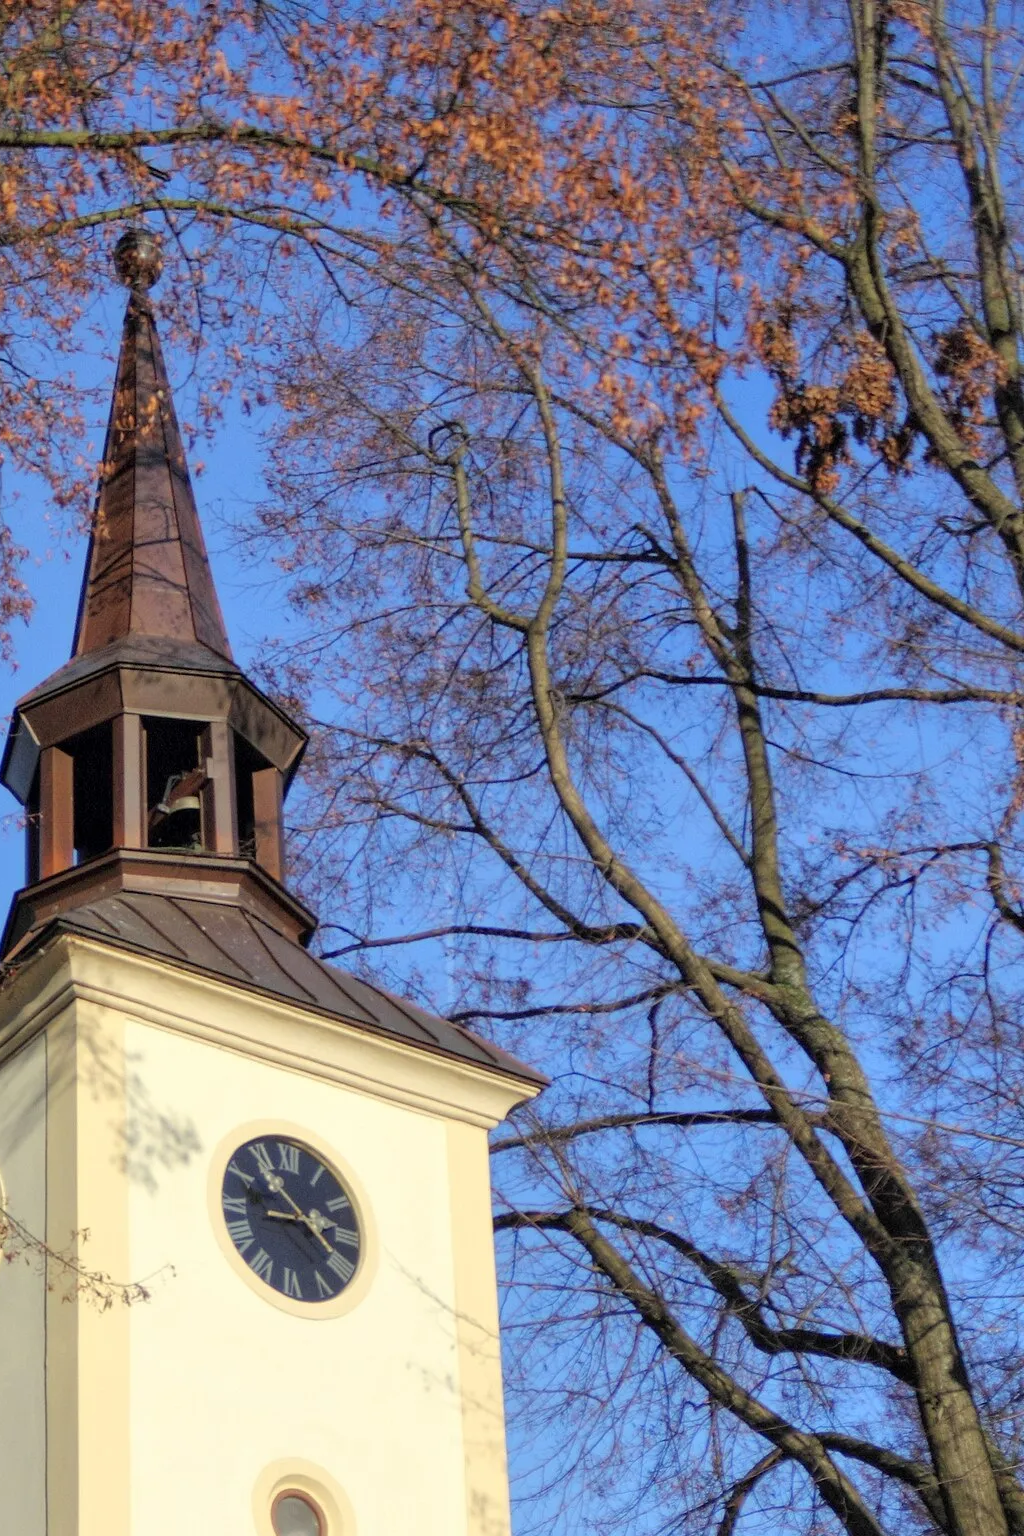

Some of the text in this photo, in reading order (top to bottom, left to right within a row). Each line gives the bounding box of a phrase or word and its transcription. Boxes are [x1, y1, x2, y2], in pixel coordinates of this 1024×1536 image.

[248, 1143, 275, 1171] XI
[277, 1143, 300, 1174] XII
[228, 1161, 255, 1188] X
[310, 1165, 325, 1187] I
[223, 1195, 247, 1214] IX
[326, 1196, 349, 1212] II
[227, 1220, 255, 1254] VIII
[335, 1227, 358, 1248] III
[250, 1248, 273, 1284] VII
[327, 1251, 355, 1283] IIII
[283, 1267, 303, 1298] VI
[315, 1270, 334, 1298] V
